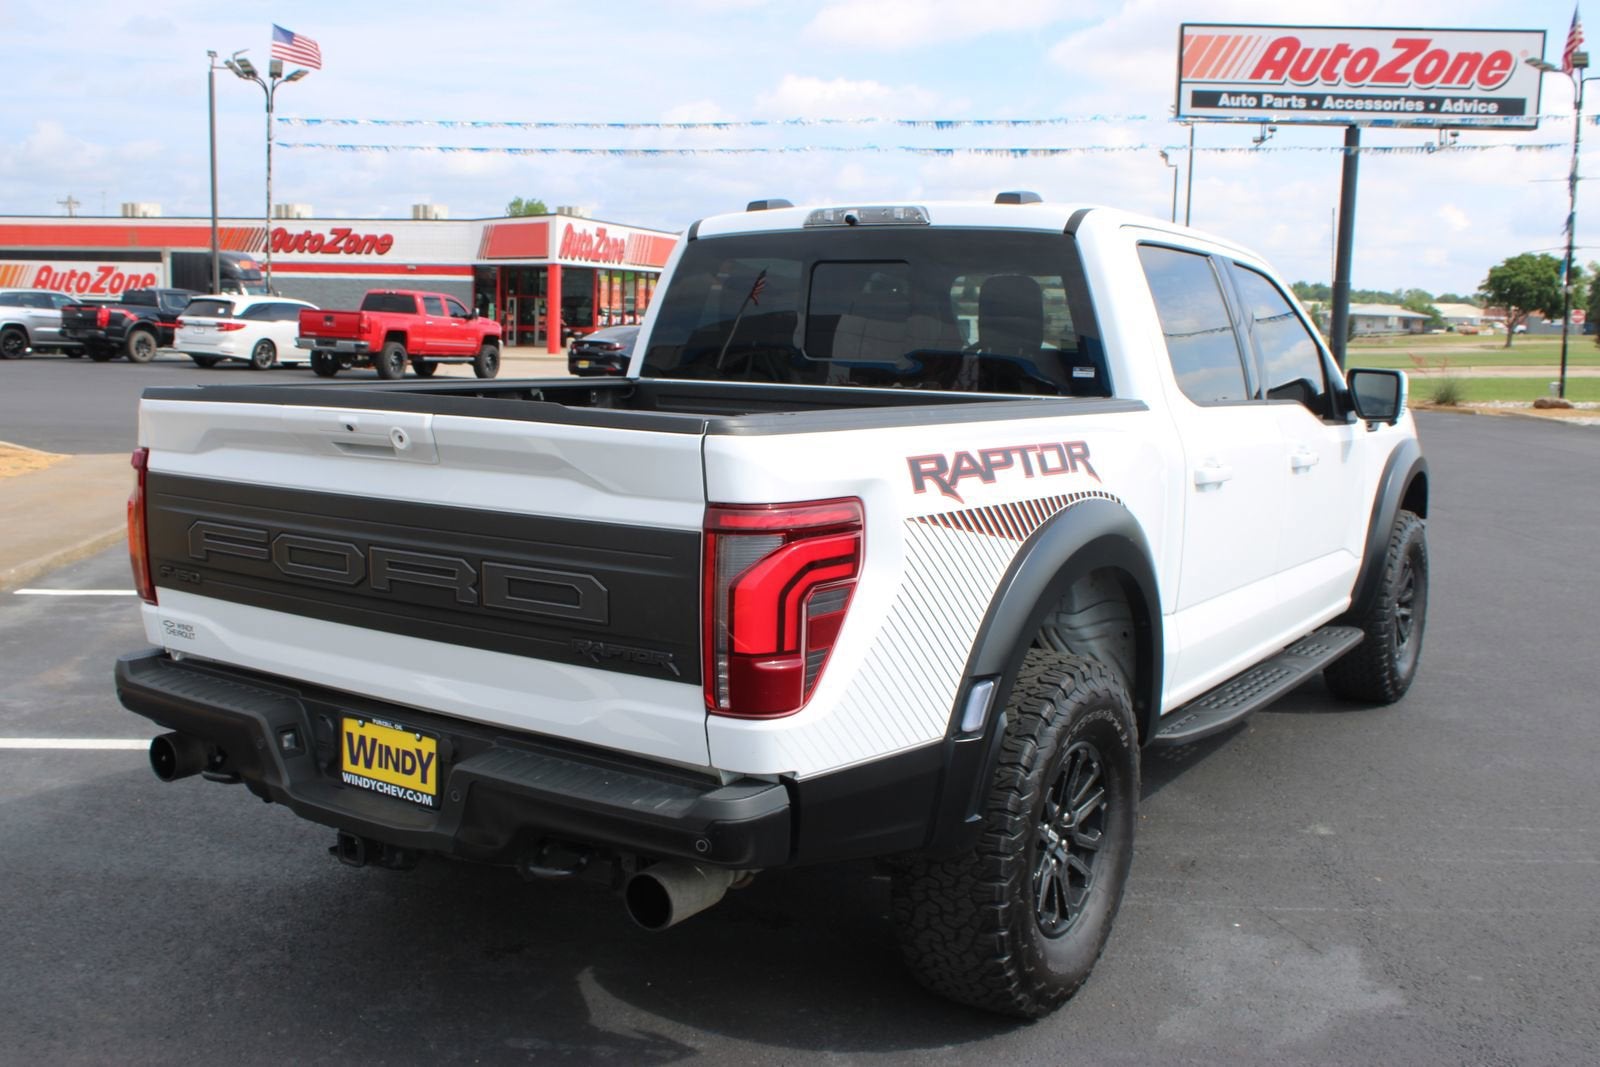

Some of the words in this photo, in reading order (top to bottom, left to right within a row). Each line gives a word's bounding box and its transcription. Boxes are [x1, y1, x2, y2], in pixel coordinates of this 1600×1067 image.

[1248, 36, 1514, 87] AutoZone
[1218, 93, 1257, 107] Auto
[1261, 94, 1307, 109] Parts
[1322, 95, 1424, 112] Accessories
[1440, 99, 1499, 114] Advice
[262, 226, 394, 256] AutoZone
[559, 222, 626, 265] AutoZone
[33, 265, 156, 295] AutoZone
[906, 440, 1102, 504] RAPTOR
[188, 520, 609, 625] FORD
[571, 638, 680, 677] RAPTOR
[346, 731, 435, 785] WINDY
[342, 772, 433, 806] WINDYCHEV.COM
